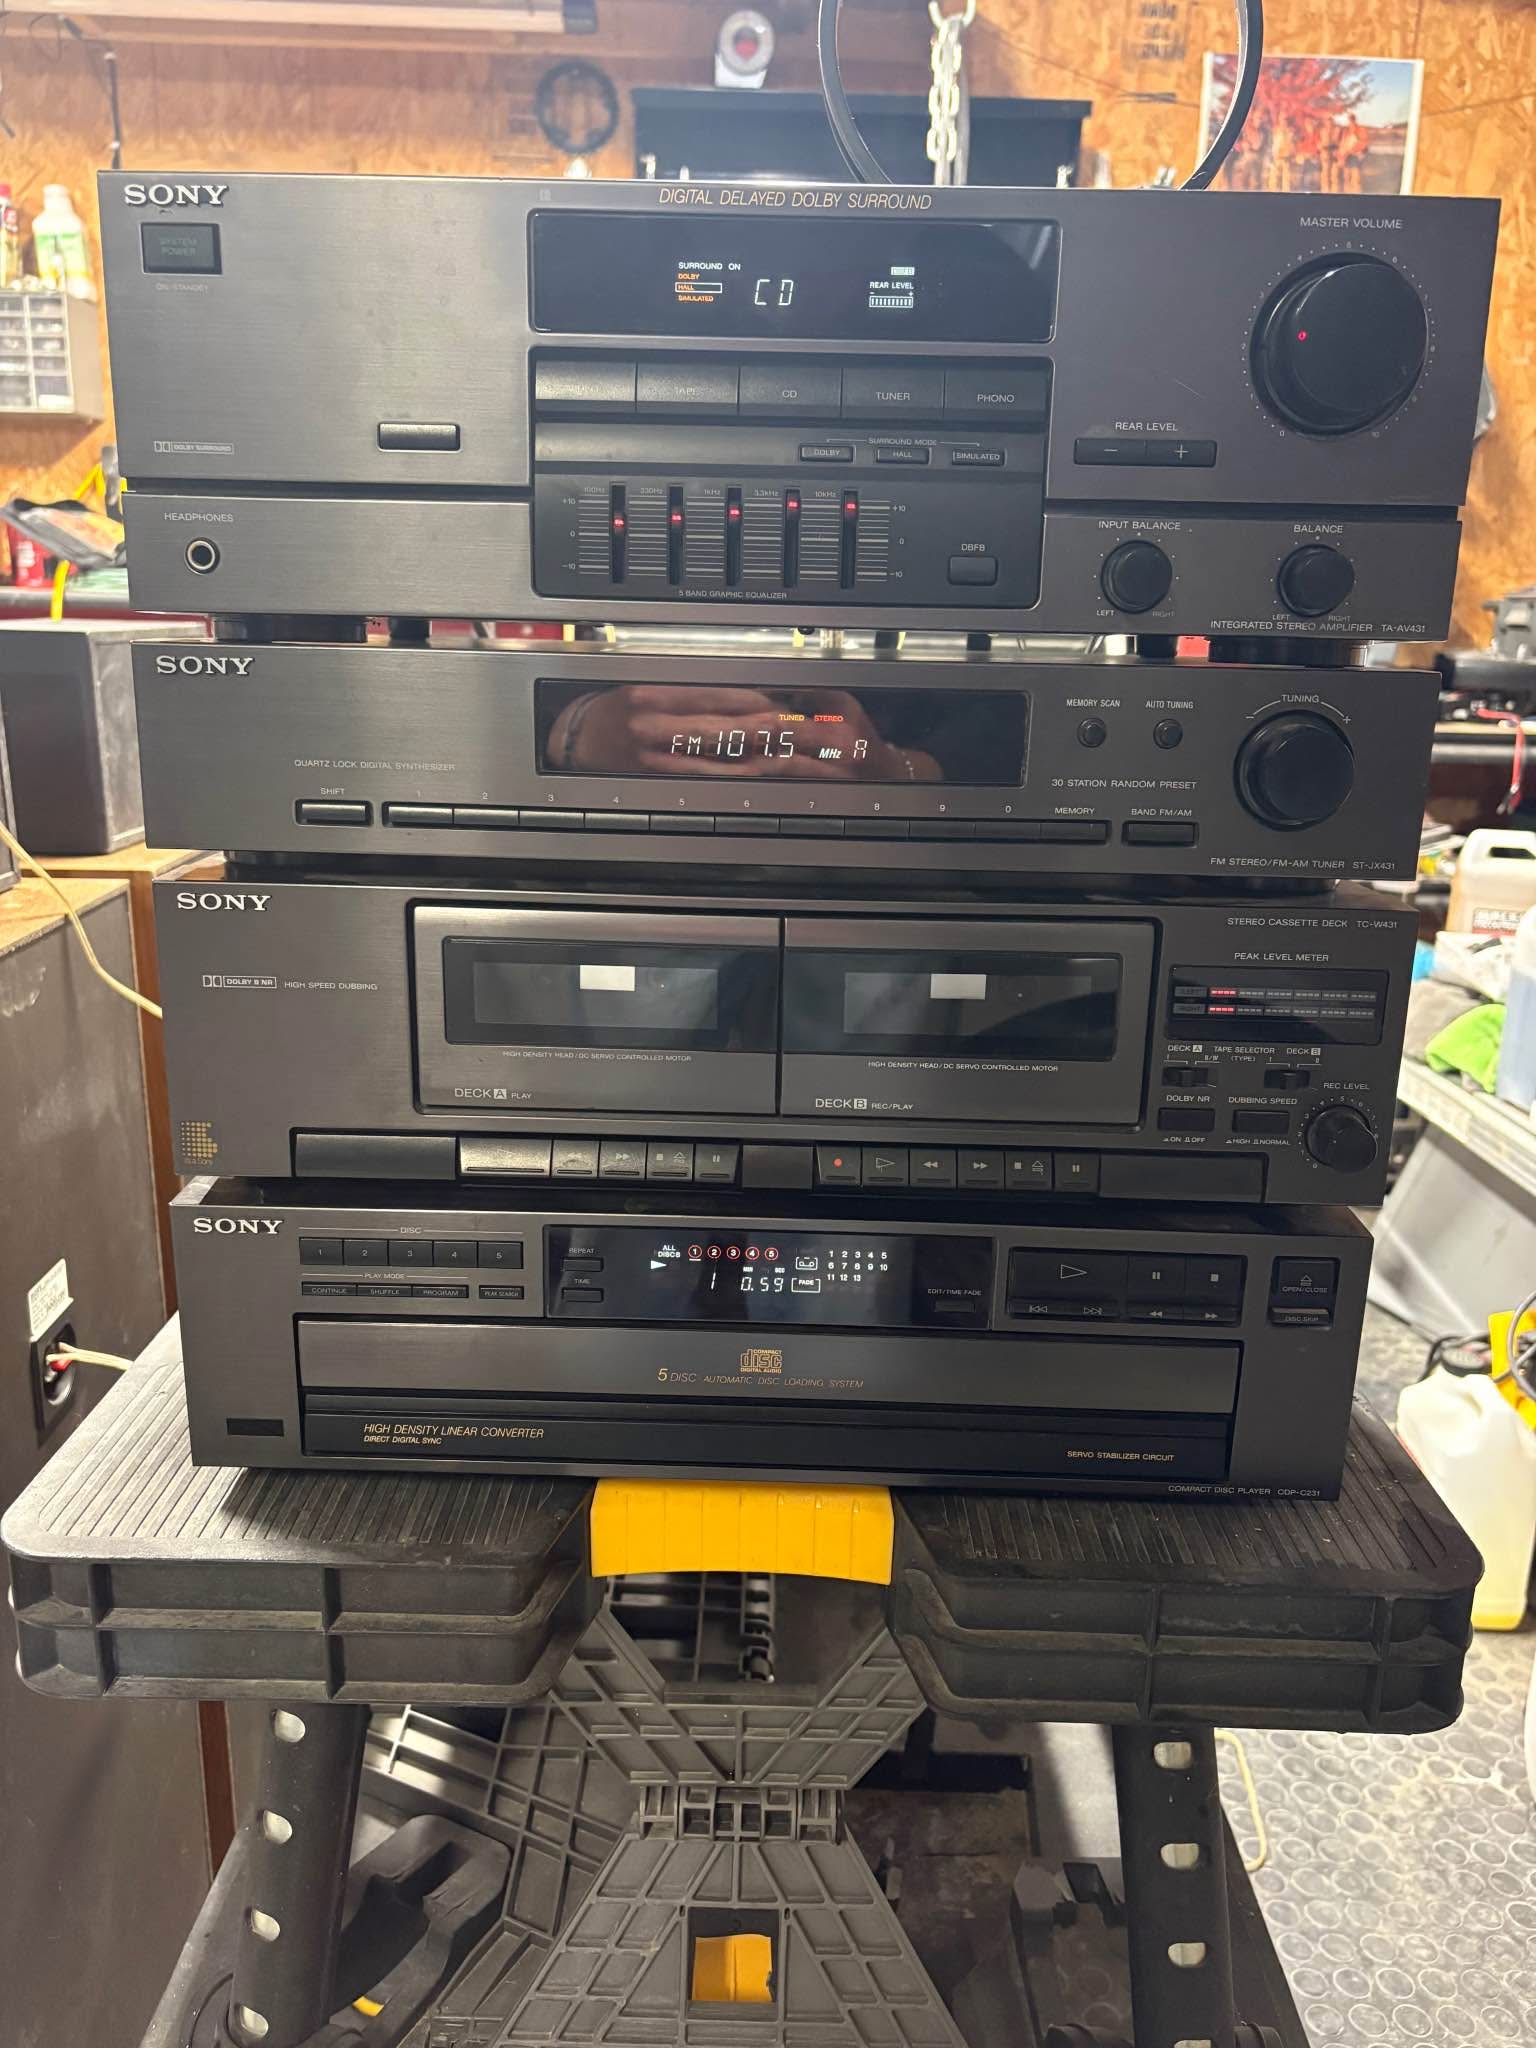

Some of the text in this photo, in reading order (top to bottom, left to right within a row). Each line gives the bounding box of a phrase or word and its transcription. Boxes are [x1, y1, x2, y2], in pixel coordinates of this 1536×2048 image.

[124, 184, 228, 206] SONY
[659, 188, 930, 209] DIGITAL DELAYED DOLBY SURROUND
[1300, 217, 1403, 229] MASTER VOLUME
[679, 262, 741, 271] SURROUND ON
[870, 281, 888, 289] REAR
[755, 279, 794, 306] CD
[876, 392, 910, 400] TUNER
[977, 394, 1015, 402] PHONO
[1115, 422, 1177, 431] REAR LEVEL
[164, 513, 234, 522] HEADPHONES
[1098, 520, 1181, 530] INPUT BALANCE
[1294, 524, 1343, 533] BALANCE
[961, 543, 985, 551] DBFB
[1211, 621, 1425, 633] INTEGRATED STEREO AMPLIFIER TA-AV431
[155, 656, 254, 675] SONY
[1067, 699, 1098, 707] MEMORY
[1282, 694, 1319, 703] TUNING
[1167, 701, 1193, 709] TUNING
[672, 735, 700, 754] FM
[819, 748, 842, 760] MHz
[295, 759, 329, 767] QUARTZ
[360, 761, 391, 769] DIGITAL
[396, 762, 455, 771] SYNTHESIZER
[1052, 779, 1196, 789] 30 STATION RANDOM PRESET
[320, 787, 345, 795] SHIFT
[1055, 807, 1095, 815] MEMORY
[1131, 808, 1192, 817] BAND FM/AM
[1229, 858, 1308, 868] STEREO/FM-AM
[1313, 861, 1345, 869] TUNER
[1353, 861, 1395, 870] ST-JX431
[177, 893, 271, 911] SONY
[1228, 918, 1265, 926] STEREO
[1269, 919, 1318, 927] CASSETTE
[1322, 920, 1348, 928] DECK
[1296, 954, 1328, 962] METER
[227, 978, 251, 986] DOLBY
[262, 978, 273, 986] NR
[308, 982, 336, 990] SPEED
[338, 983, 377, 991] DUBBING
[455, 1088, 491, 1098] DECK
[494, 1088, 506, 1099] A
[815, 1099, 913, 1111] DECK B REC/PLAY
[193, 1218, 283, 1234] SONY
[657, 1369, 863, 1388] 5 DISC AUTOMATIC DISC LOADING SYSTEM
[364, 1424, 544, 1438] HIGH DENSITY LINEAR CONVERTER
[422, 1437, 441, 1445] SYNC
[1097, 1452, 1140, 1460] STABILIZER
[1143, 1453, 1174, 1461] CIRCUIT
